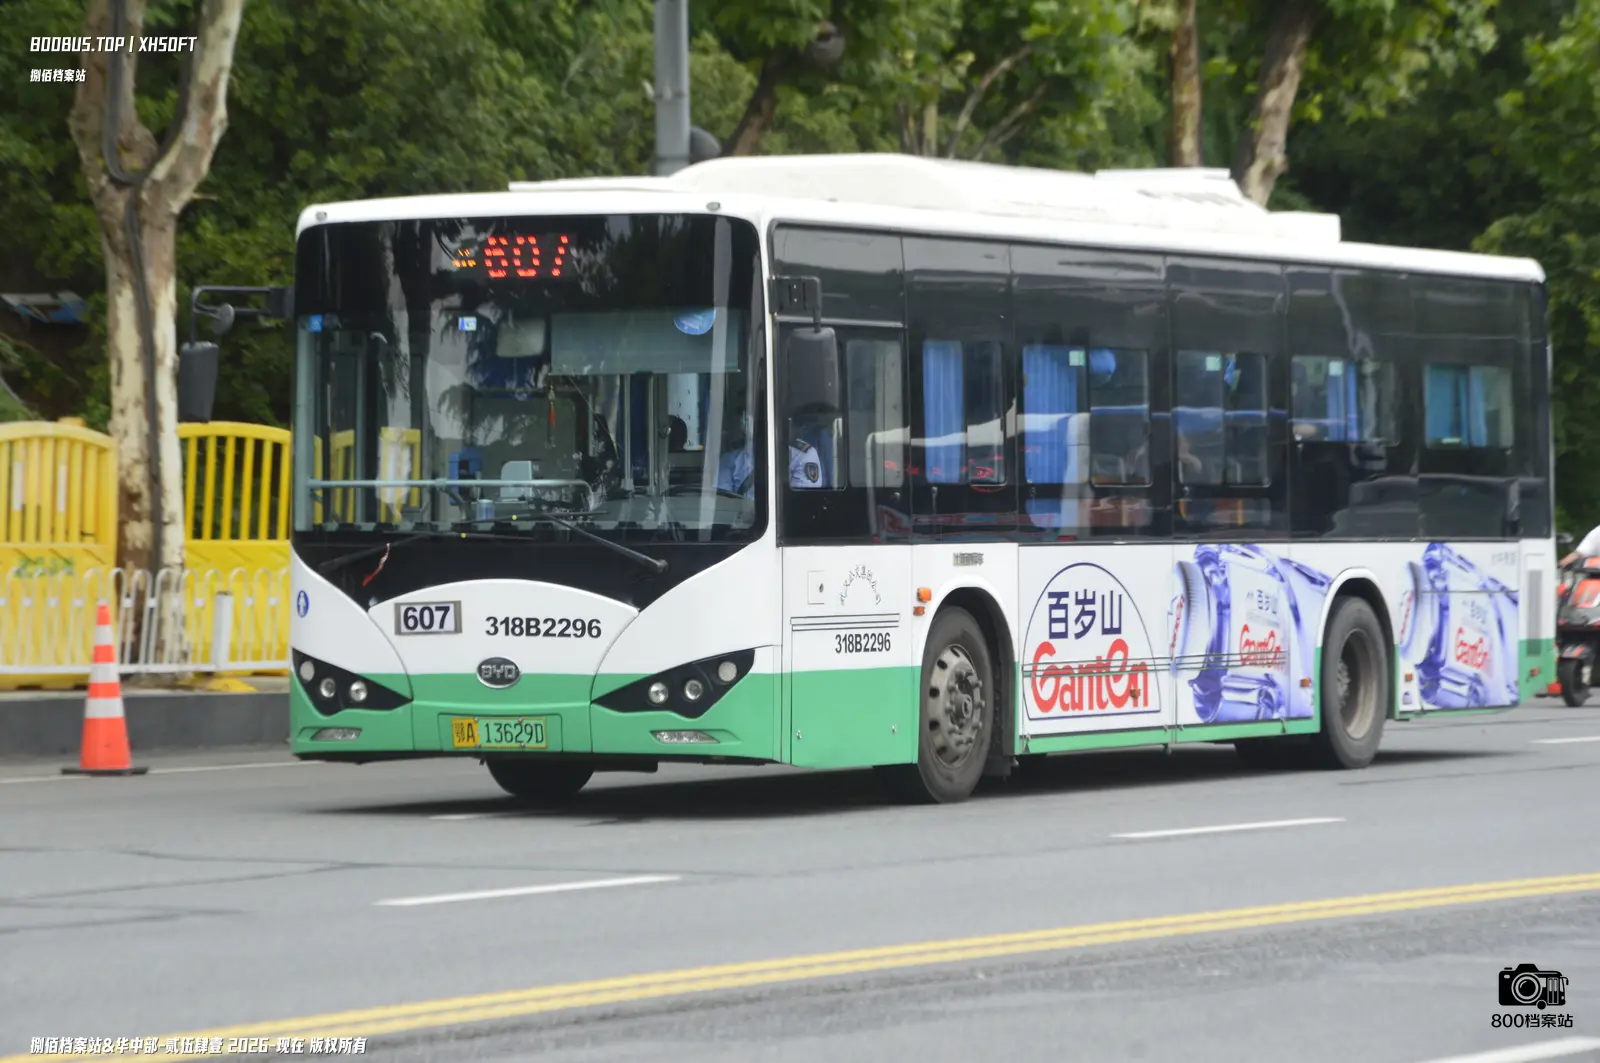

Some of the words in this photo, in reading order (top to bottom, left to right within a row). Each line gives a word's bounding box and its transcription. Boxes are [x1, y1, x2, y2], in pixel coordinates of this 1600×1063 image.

[403, 605, 451, 631] 607
[1047, 588, 1123, 640] 百岁山
[485, 616, 602, 639] 318B2296
[835, 632, 891, 654] 318B2296
[481, 664, 516, 679] BYD
[484, 722, 545, 744] 13629D
